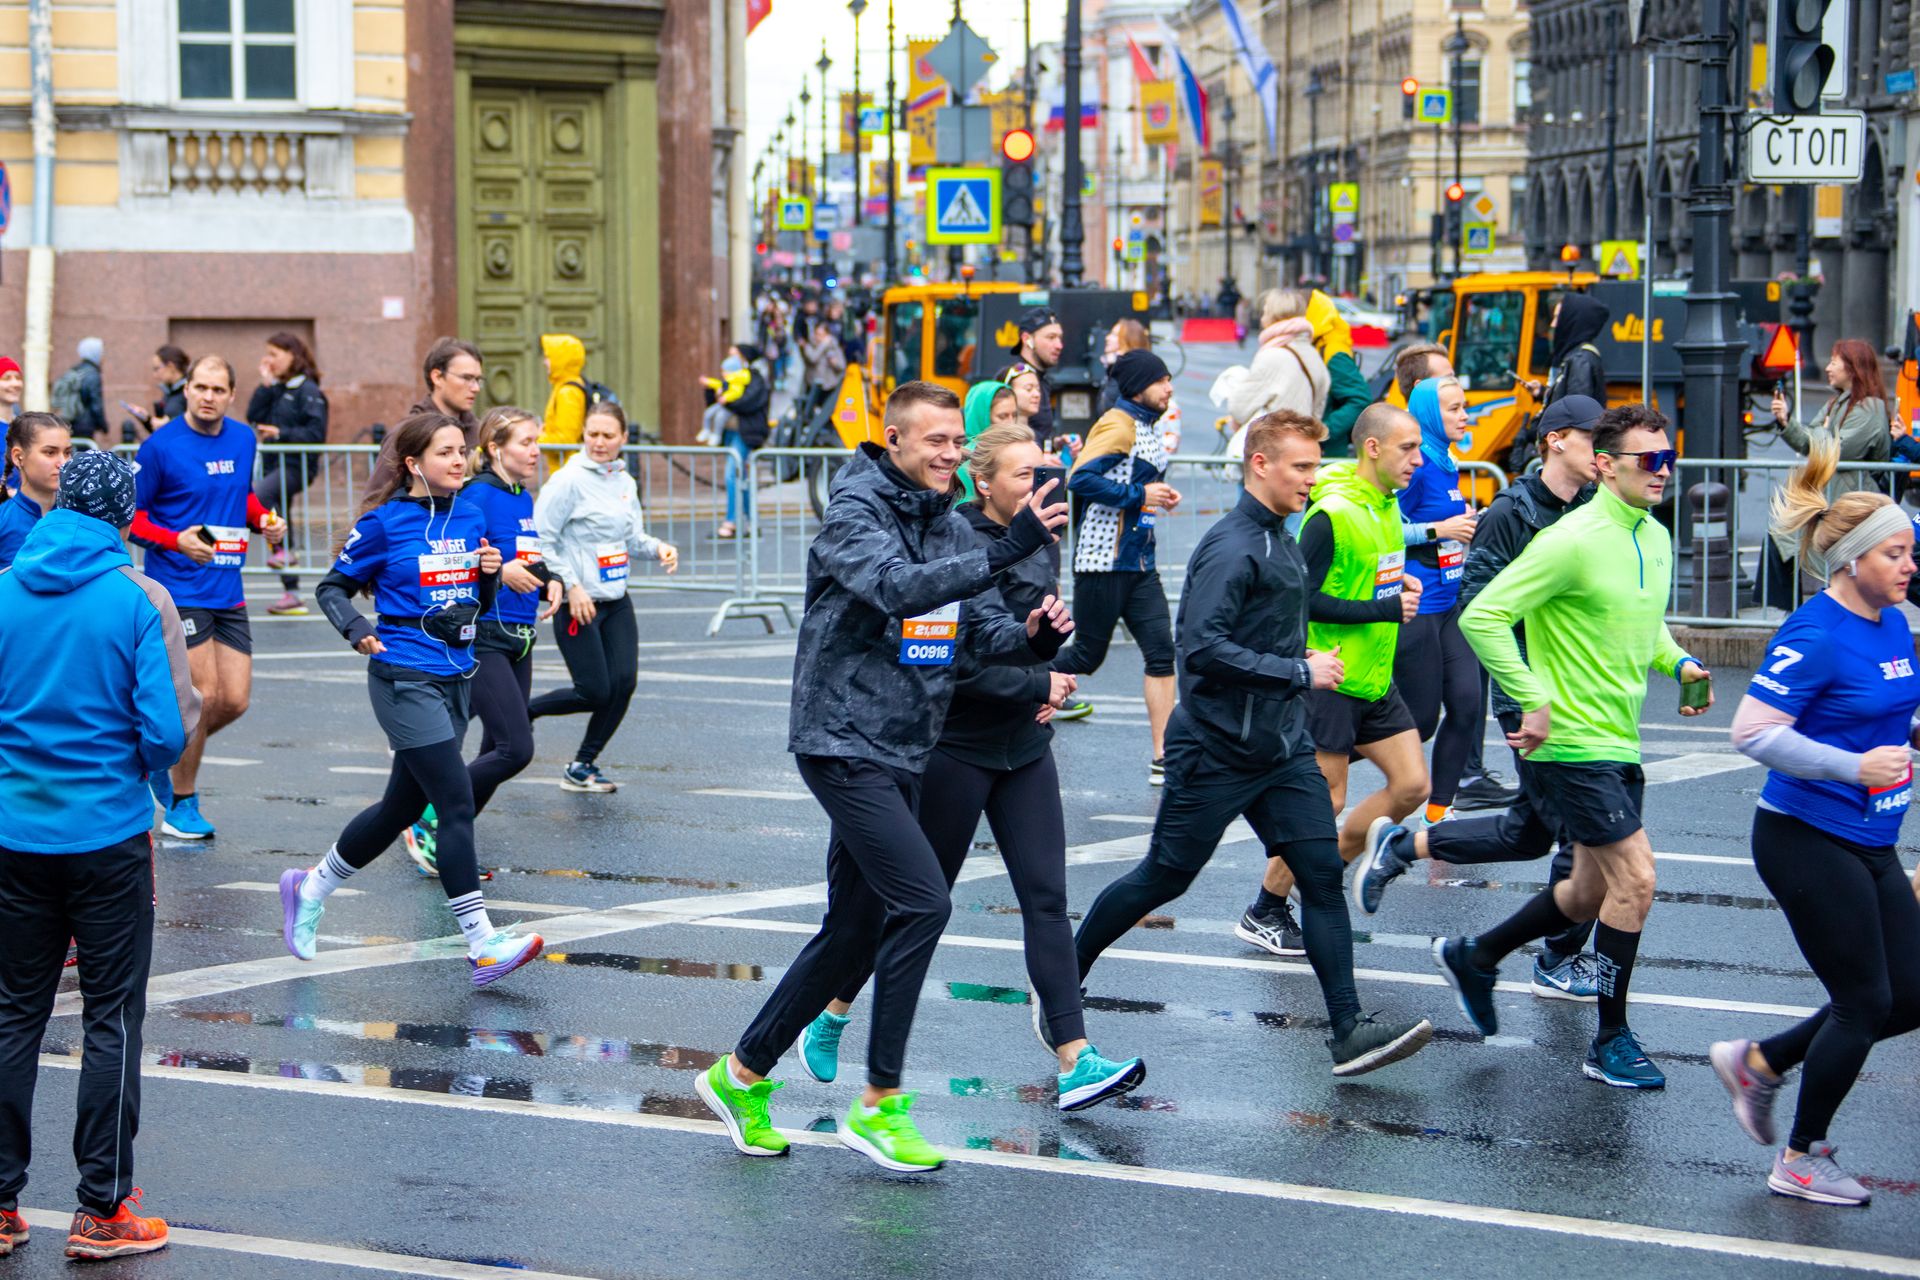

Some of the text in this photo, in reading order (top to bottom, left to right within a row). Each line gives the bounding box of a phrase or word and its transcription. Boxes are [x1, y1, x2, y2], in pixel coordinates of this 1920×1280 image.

[1767, 127, 1847, 166] СТОП
[430, 587, 473, 601] 13961
[907, 644, 949, 659] 00916
[1768, 645, 1804, 674] 7
